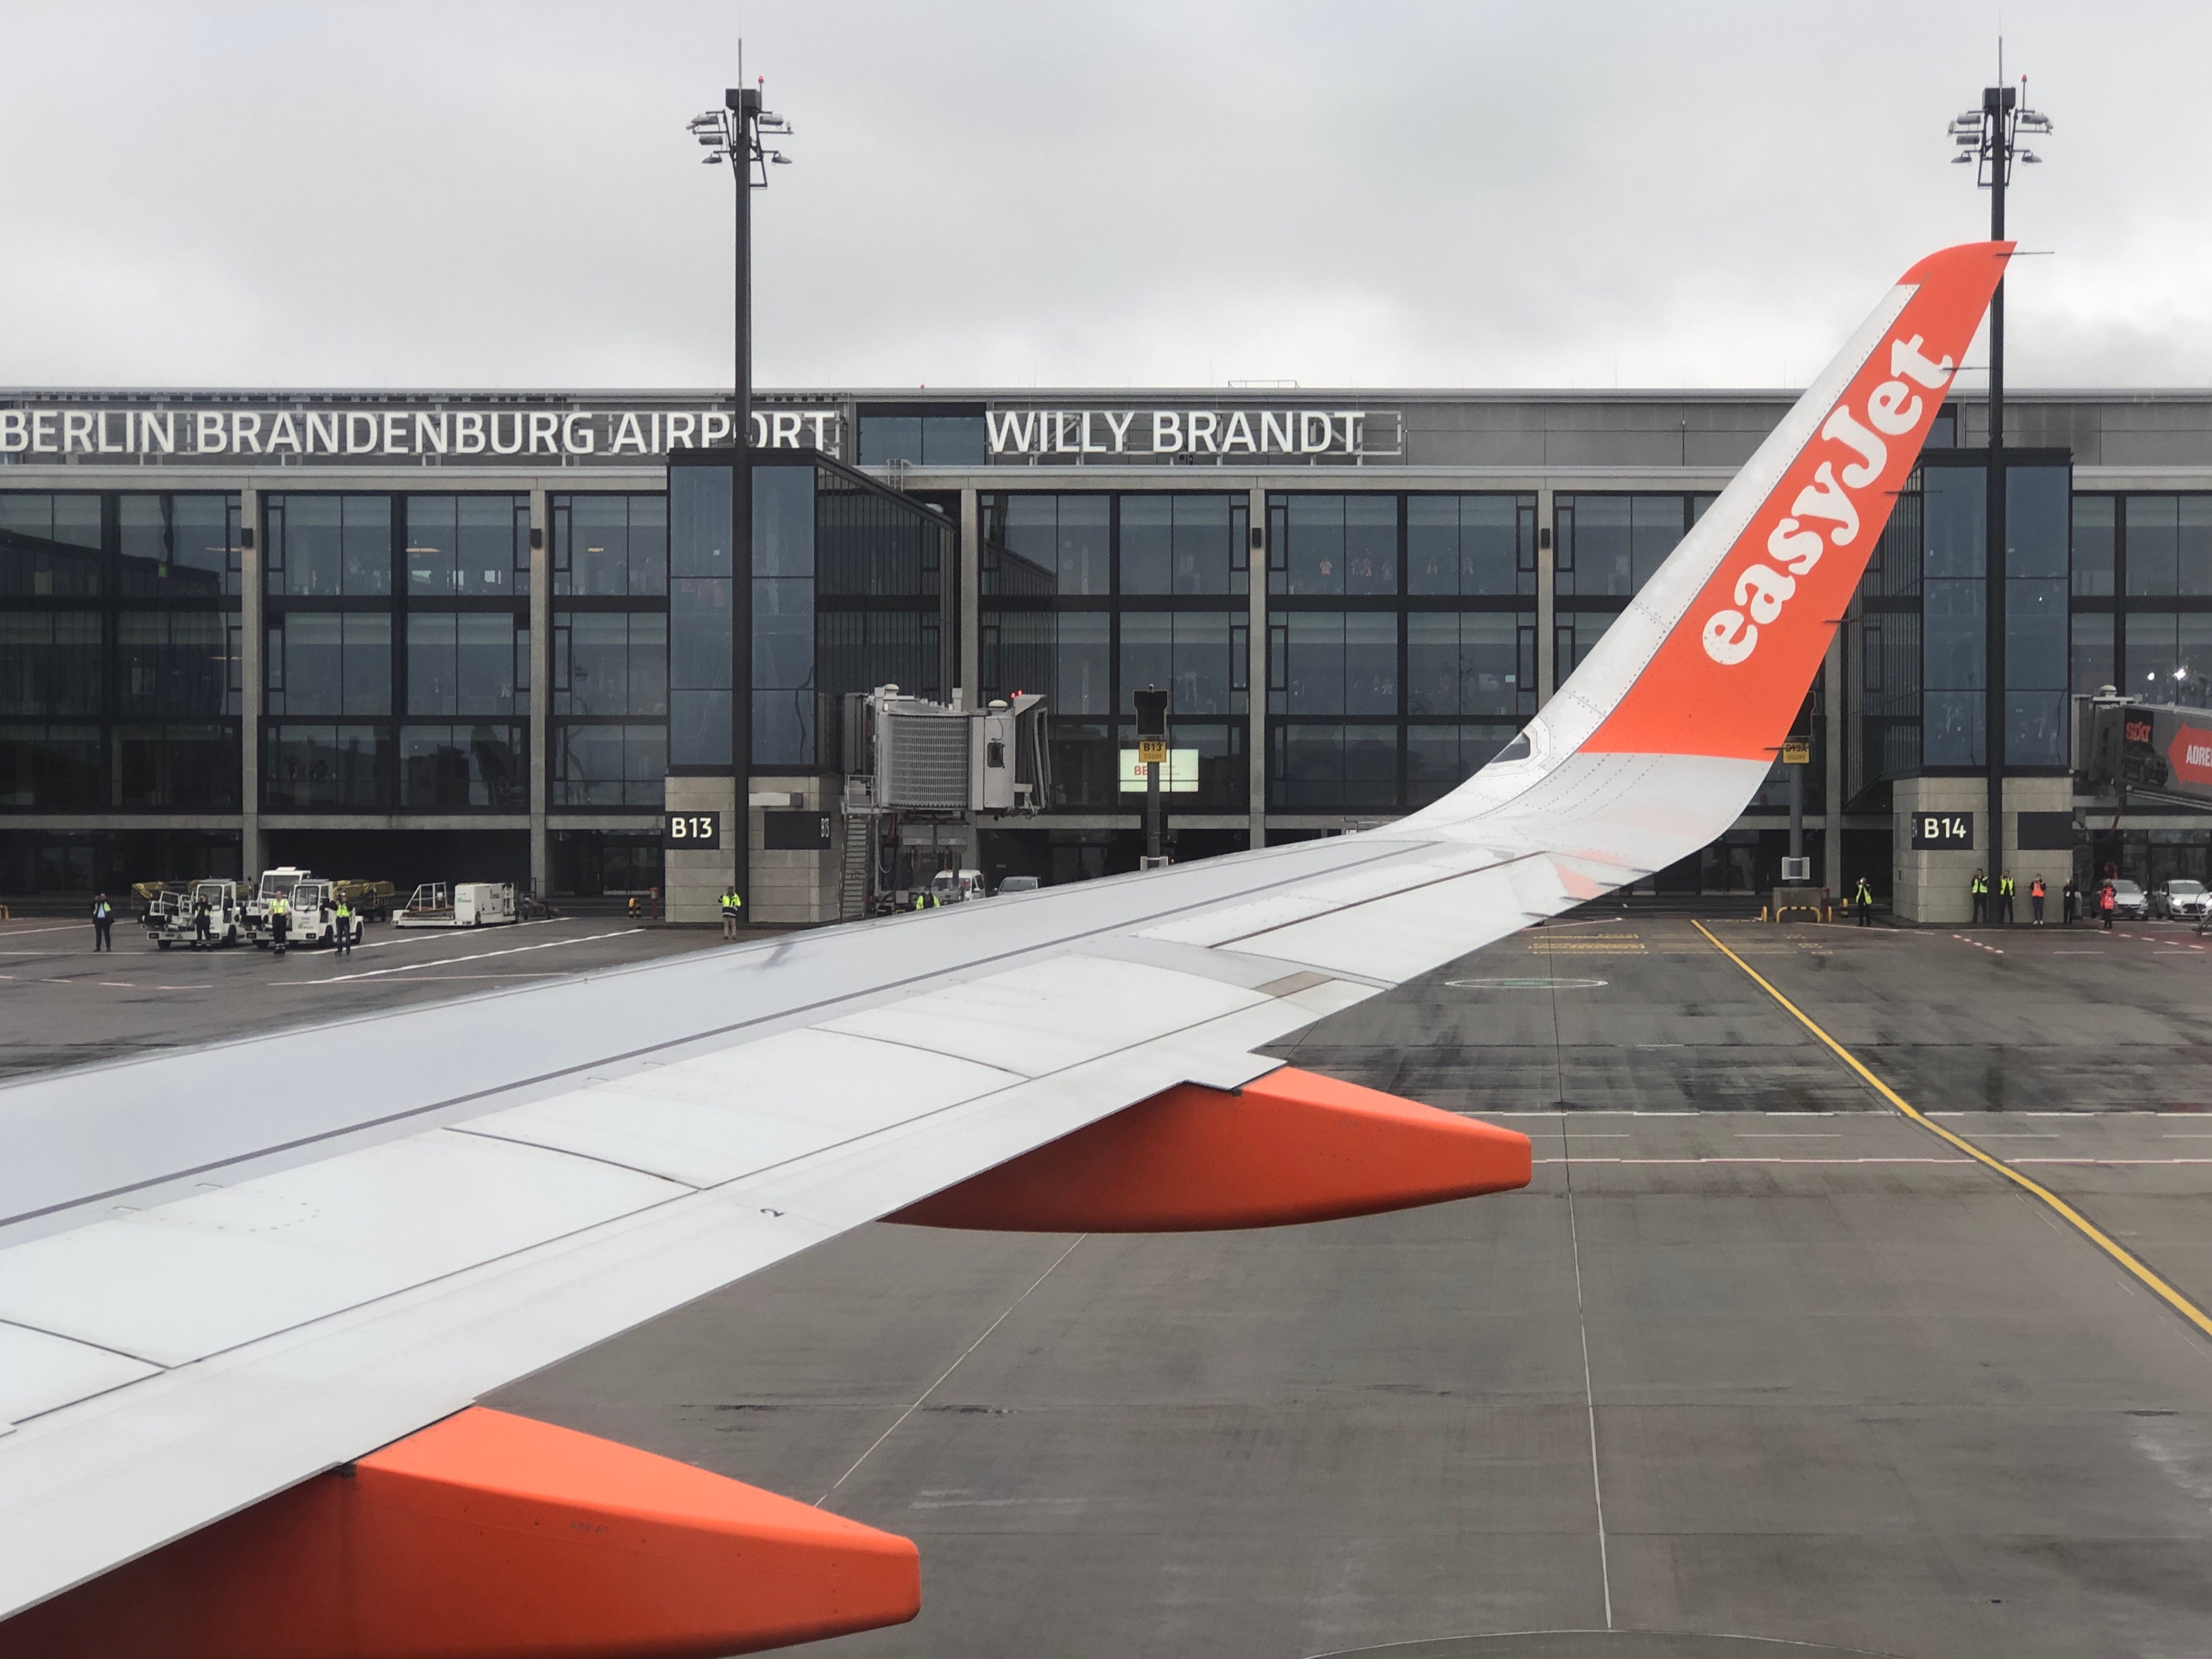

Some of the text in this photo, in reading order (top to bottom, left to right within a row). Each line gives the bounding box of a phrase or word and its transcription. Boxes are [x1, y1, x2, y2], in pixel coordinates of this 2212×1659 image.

[0, 411, 174, 452] BERLIN
[197, 411, 594, 453] BRANDENBURG
[985, 411, 1135, 453] WILLY
[1153, 411, 1365, 453] BRANDT
[1702, 334, 1953, 665] easyJet
[1144, 743, 1161, 751] B13
[2185, 744, 2212, 767] ADRE
[1134, 766, 1147, 775] BE
[672, 817, 712, 838] B13
[1924, 818, 1967, 838] B14
